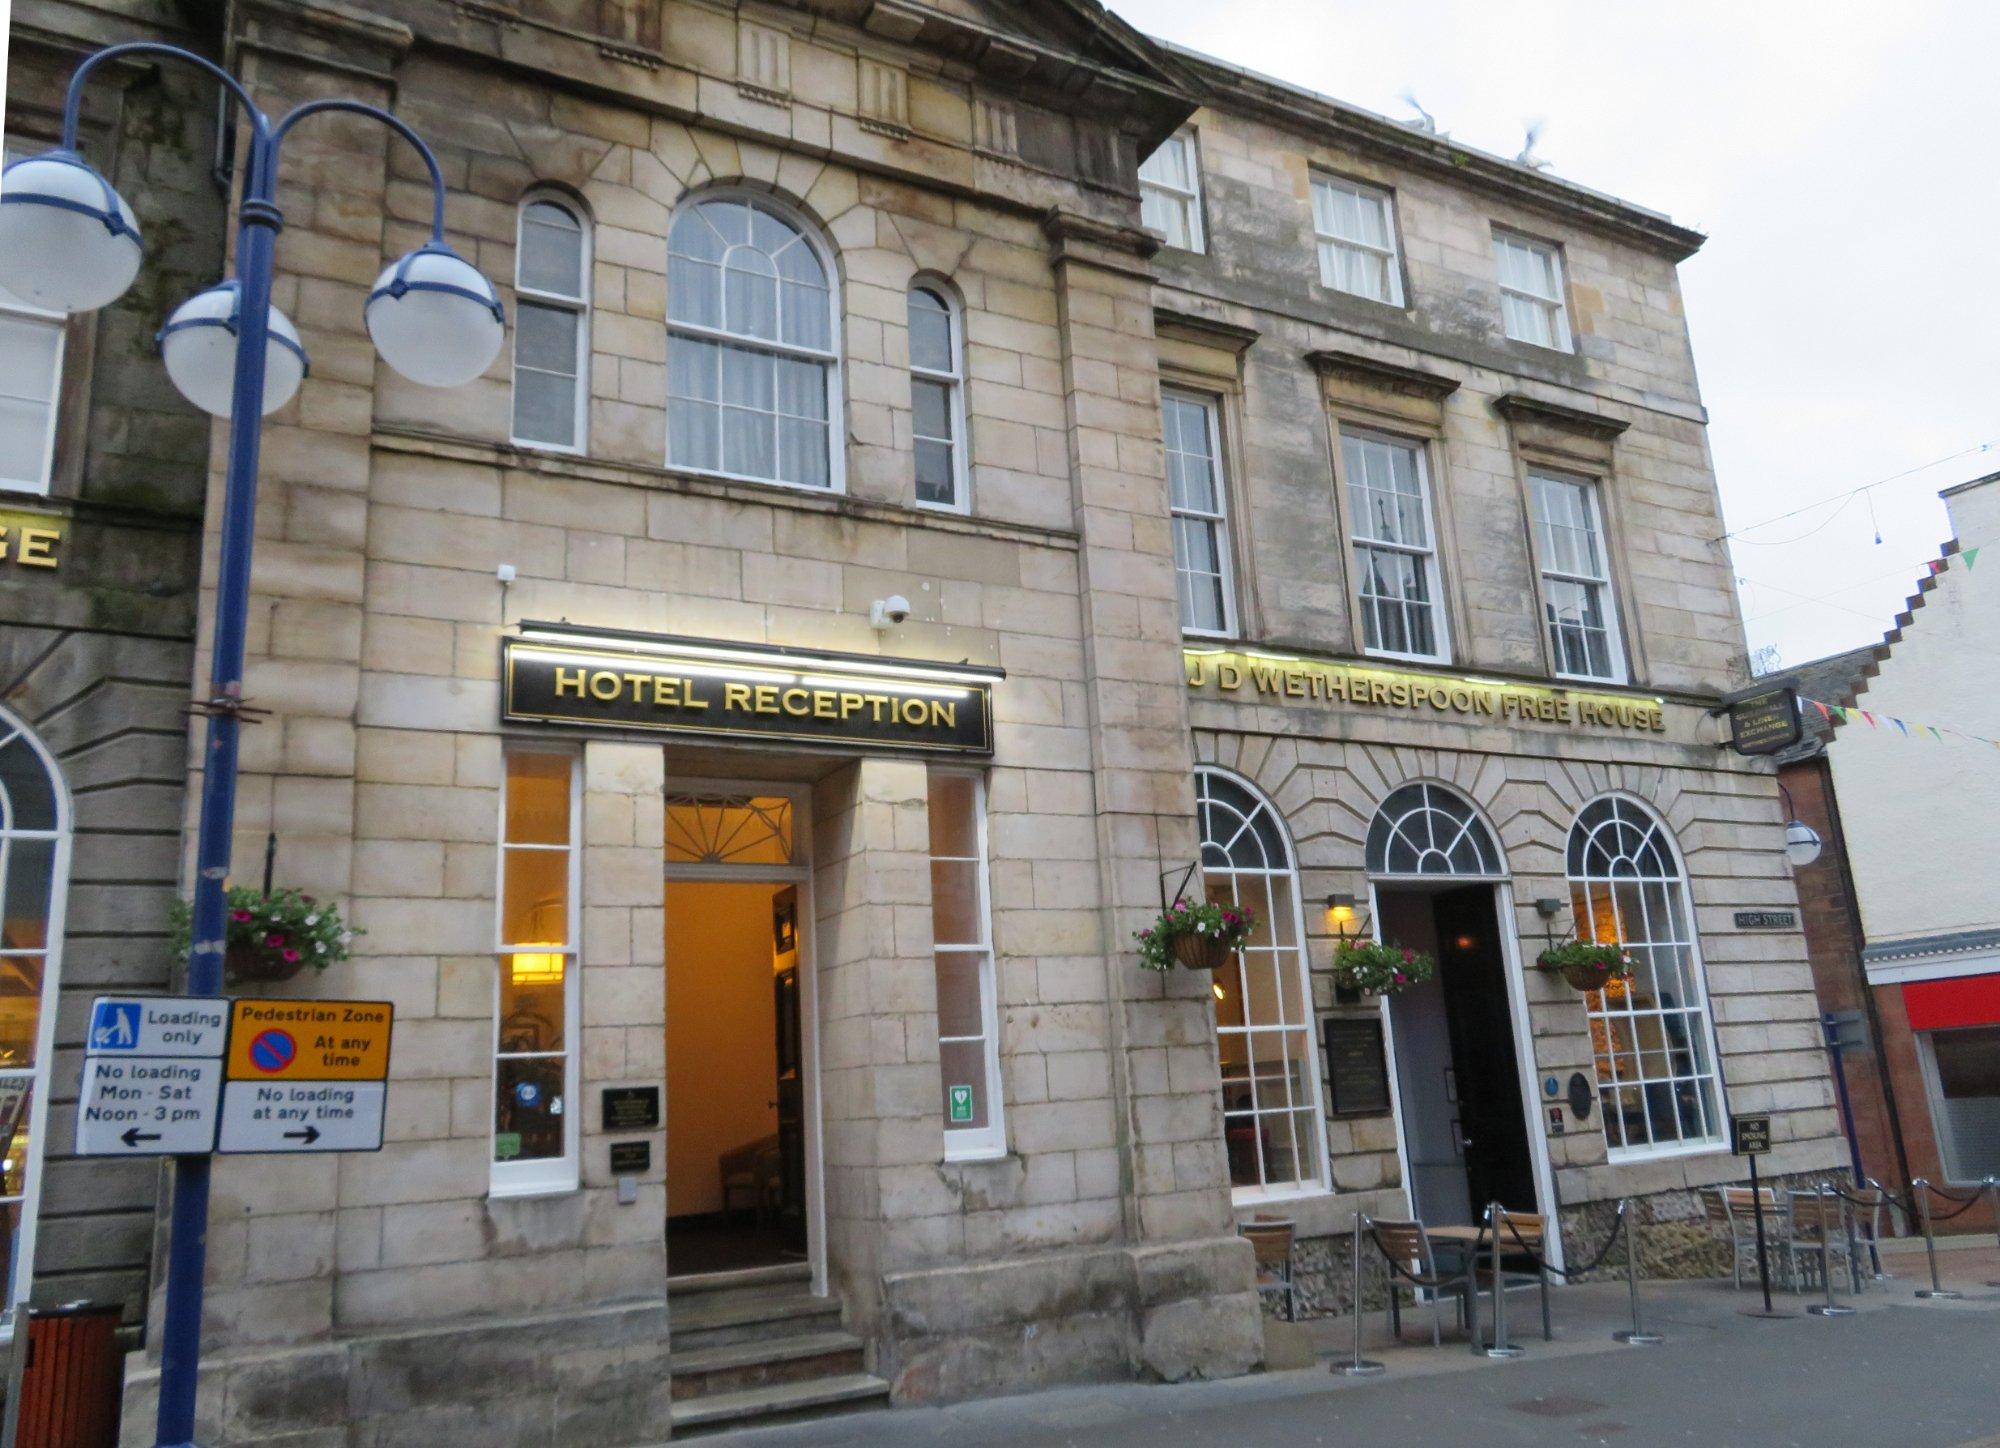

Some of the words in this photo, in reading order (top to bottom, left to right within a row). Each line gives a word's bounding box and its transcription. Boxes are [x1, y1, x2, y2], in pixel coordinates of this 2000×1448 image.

[0, 525, 60, 568] E
[555, 667, 709, 708] HOTEL
[724, 682, 956, 728] RECEPTION
[1187, 661, 1206, 687] J
[1217, 662, 1242, 690] D
[1250, 664, 1493, 715] WETHERSPOON
[1500, 693, 1572, 723] FREE
[1578, 700, 1666, 732] HOUSE
[1738, 913, 1760, 926] HIGH
[1762, 914, 1792, 926] STREET
[148, 1010, 221, 1027] Loading
[241, 1007, 336, 1022] Pedestrian
[343, 1009, 384, 1023] Zone
[162, 1029, 203, 1045] only
[314, 1036, 335, 1049] At
[341, 1038, 371, 1051] any
[322, 1054, 361, 1066] time
[96, 1065, 122, 1079] No
[131, 1065, 200, 1082] loading
[101, 1086, 142, 1100] Mon
[159, 1085, 192, 1100] Sat
[257, 1088, 283, 1101] No
[290, 1088, 354, 1103] loading
[85, 1106, 138, 1121] Noon
[253, 1106, 270, 1119] at
[278, 1108, 309, 1121] any
[316, 1105, 354, 1119] time
